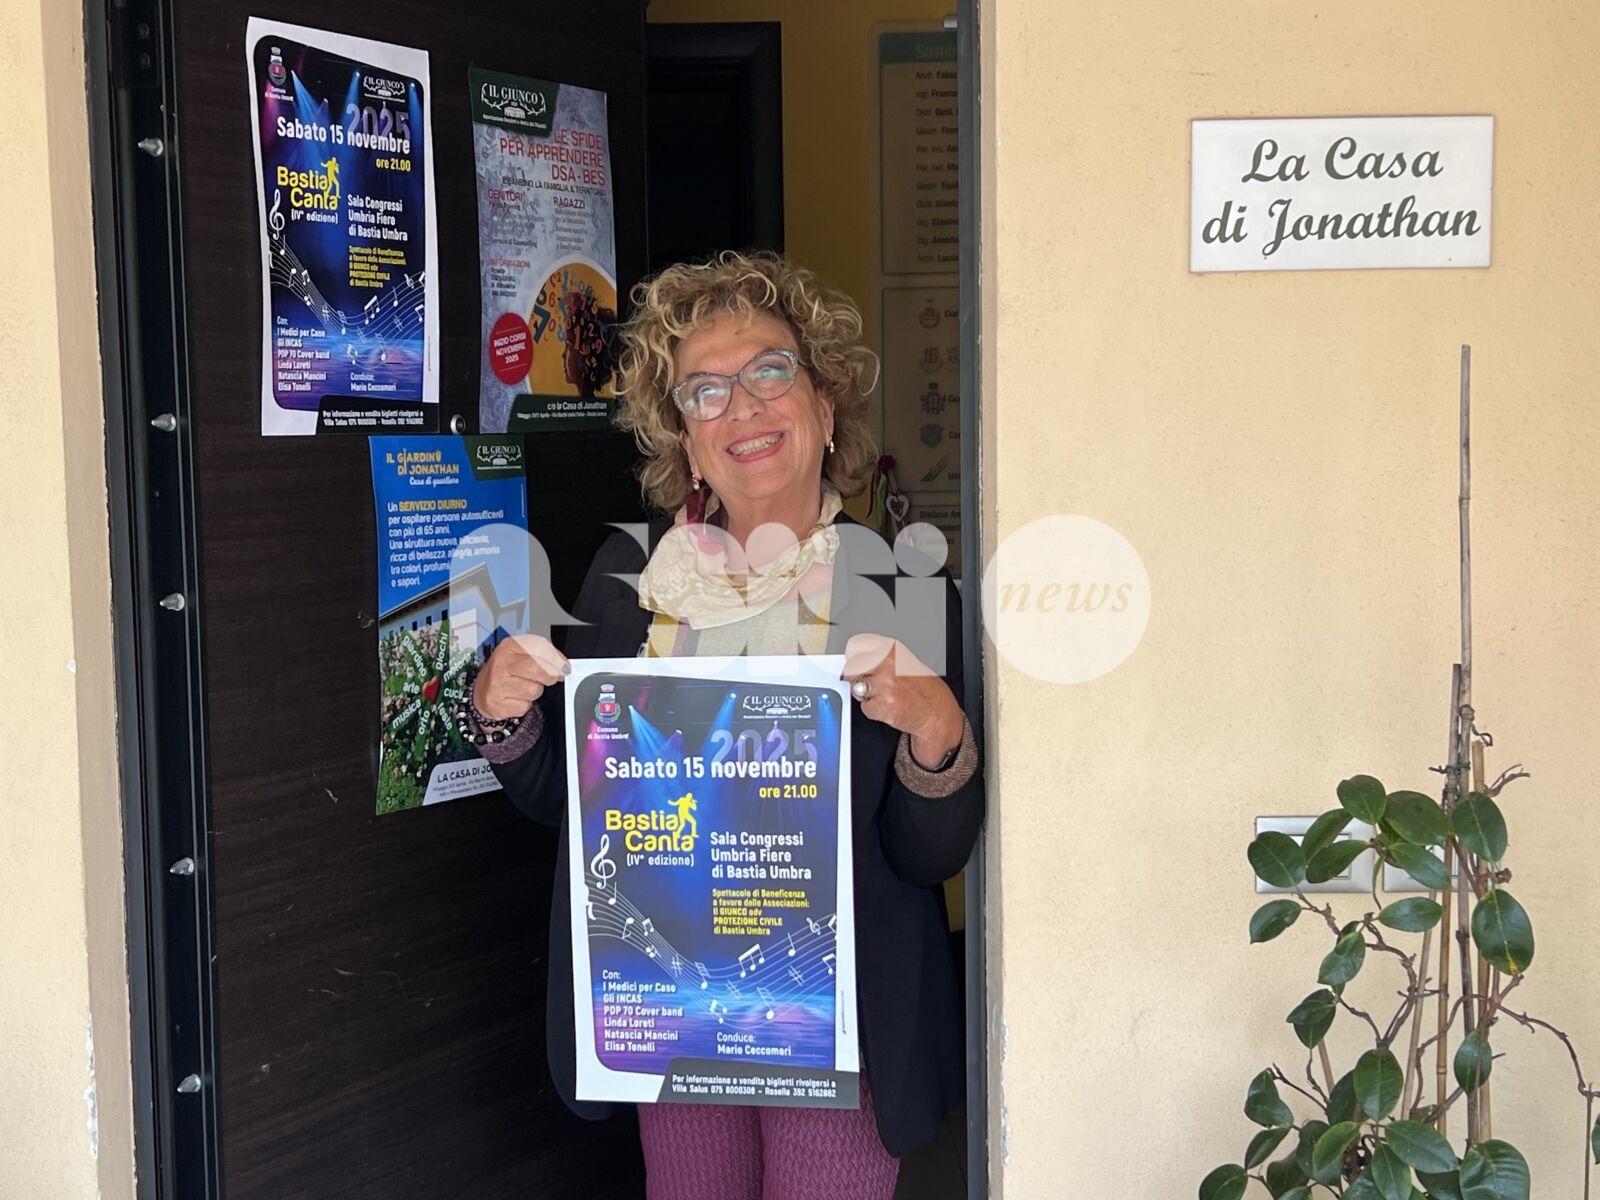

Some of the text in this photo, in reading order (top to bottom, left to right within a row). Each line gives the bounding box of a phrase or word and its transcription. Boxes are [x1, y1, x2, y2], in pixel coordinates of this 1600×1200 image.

[489, 84, 538, 104] IL GIUNCO
[346, 103, 410, 140] 2025
[277, 117, 411, 154] Sabato 15 novembre
[554, 128, 602, 149] LE SFIDE
[500, 138, 604, 168] PER APPRENDERE
[1242, 136, 1444, 183] La Casa
[376, 158, 411, 172] ore 21.00
[276, 166, 328, 190] Bastia
[552, 164, 605, 186] DSA BES
[290, 187, 338, 210] Canta
[488, 189, 523, 201] GENITORI
[347, 194, 403, 214] Sala Congressi
[553, 197, 585, 209] RAGAZZI
[306, 211, 339, 224] edizione)
[348, 209, 396, 225] Umbria Fiere
[1202, 195, 1481, 256] di Jonathan
[349, 225, 408, 242] di Bastia Umbra
[494, 332, 526, 347] INIZIO CORSI
[297, 350, 314, 358] Cover
[496, 342, 526, 356] NOVEMBRE
[562, 402, 577, 410] Casa
[386, 453, 394, 463] IL
[398, 464, 460, 475] DI JONATHAN
[388, 499, 467, 512] Un SERVIZIO DIURNO
[388, 515, 400, 526] per
[402, 512, 430, 526] ospitare
[432, 513, 460, 525] persone
[389, 525, 451, 537] con di 65 anni.
[389, 540, 403, 550] Una
[404, 537, 435, 549] struttura
[390, 551, 408, 562] ricca
[409, 550, 416, 561] di
[391, 565, 400, 574] tra
[402, 634, 427, 677] giardino
[435, 632, 448, 671] giochi
[403, 682, 420, 694] arte
[751, 695, 803, 705] IL GIUNCO
[392, 699, 421, 729] musica
[418, 710, 431, 735] orto
[711, 729, 818, 770] 2025
[605, 756, 817, 779] Sabato 15 novembre
[438, 773, 448, 783] LA
[450, 768, 470, 781] CASA
[472, 767, 480, 776] DI
[759, 784, 818, 798] ore 21.00
[605, 809, 680, 831] Bastia
[625, 830, 695, 852] Canta
[710, 831, 803, 848] Sala Congressi
[648, 854, 694, 867] edizione)
[711, 848, 792, 862] Umbria Fiere
[712, 865, 812, 879] di Bastia Umbra
[712, 889, 805, 898] Spettacolo di Beneficenza
[720, 908, 747, 916] GIUNCO
[713, 917, 783, 926] PROTEZIONE CIVILE
[722, 927, 745, 935] Bastia
[747, 927, 770, 935] Umbra
[602, 969, 621, 979] Con:
[608, 982, 676, 993] Medici per Caso
[603, 993, 642, 1003] Gli INCAS
[604, 1005, 683, 1016] POP 70 Cover band
[604, 1017, 655, 1028] Linda Loreti
[604, 1029, 678, 1040] Natascia Mancini
[717, 1032, 756, 1042] Conduce:
[605, 1042, 655, 1052] Elisa Tonelli
[717, 1045, 792, 1056] Mario Ceccomori
[672, 1075, 830, 1089] Per informazione vendita biglietti rivolgersi
[672, 1084, 687, 1092] Villa
[689, 1085, 708, 1093] Salus
[711, 1085, 723, 1094] 075
